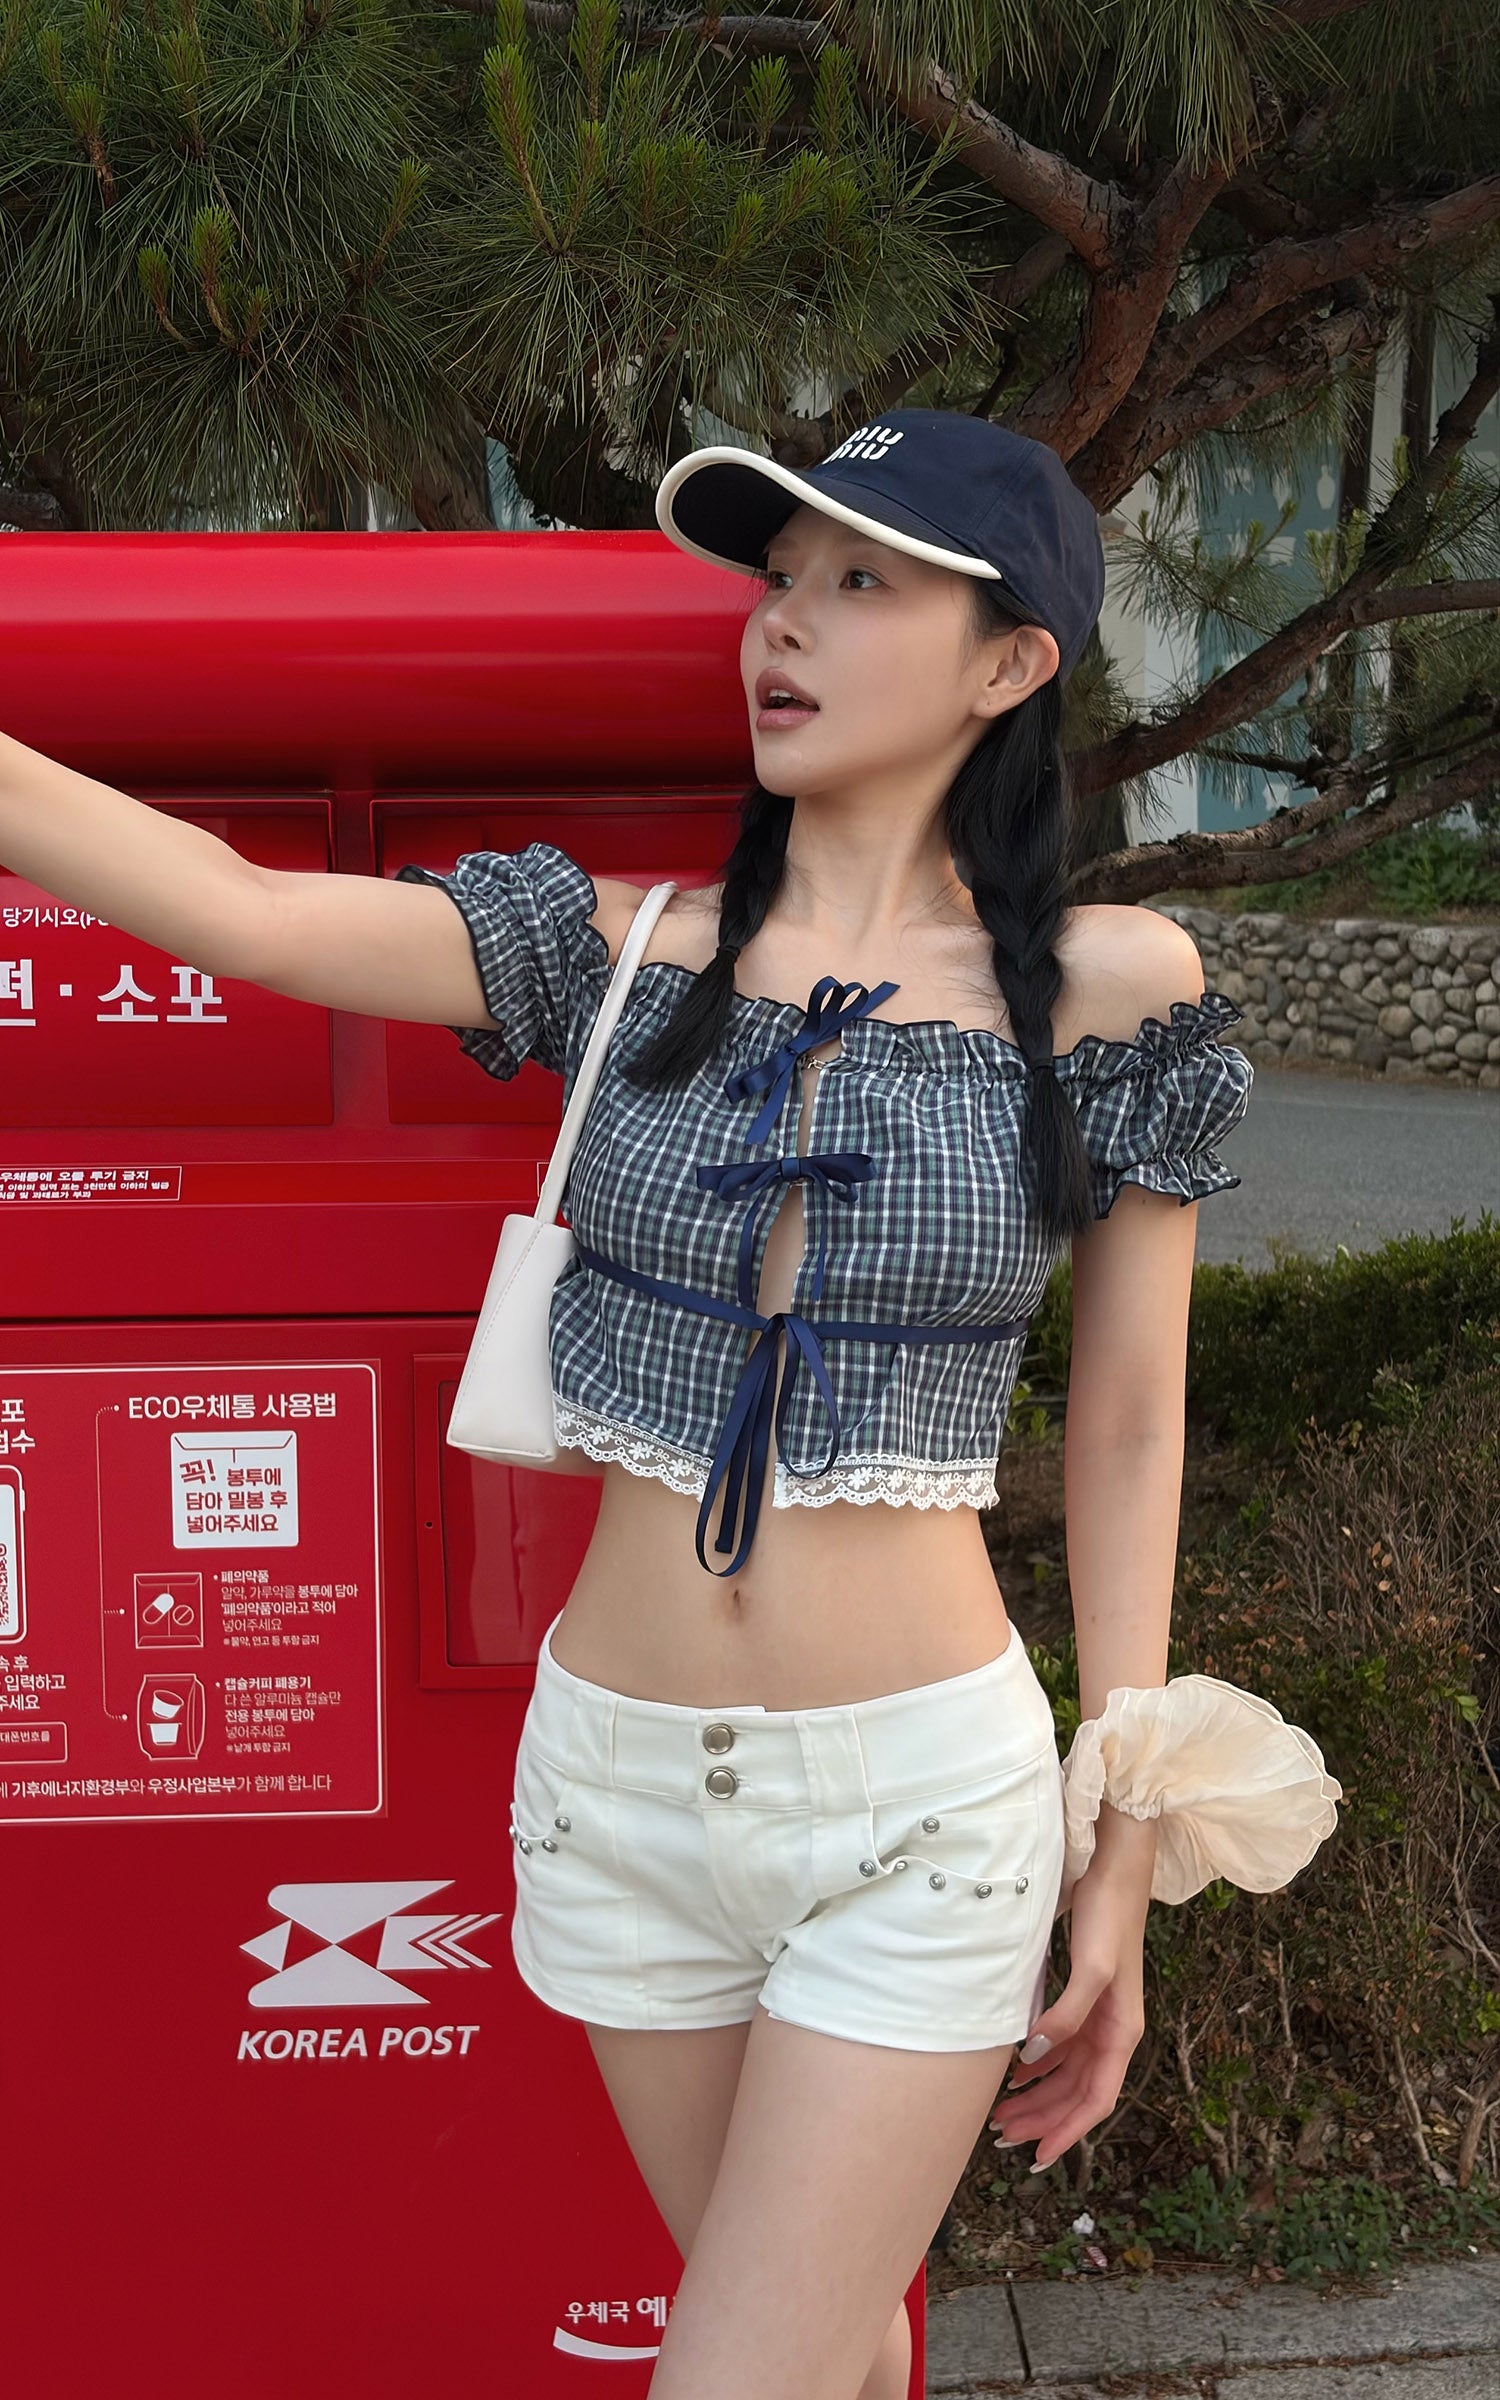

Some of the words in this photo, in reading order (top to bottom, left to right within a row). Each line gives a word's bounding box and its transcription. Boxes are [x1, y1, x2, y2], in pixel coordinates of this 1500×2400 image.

[96, 964, 228, 1024] 소포
[89, 1170, 117, 1182] 투기
[122, 1170, 149, 1181] 금지
[128, 1394, 256, 1420] ECO우체통
[262, 1392, 337, 1418] 사용법
[179, 1458, 217, 1485] 꼭!
[227, 1467, 282, 1487] 봉투에
[185, 1492, 224, 1511] 담아
[228, 1491, 265, 1510] 밀봉
[269, 1490, 289, 1509] 후
[186, 1514, 279, 1534] 넣어주세요
[221, 1570, 270, 1584] 폐의약품
[221, 1586, 248, 1600] 알약,
[250, 1585, 296, 1599] 가루약을
[298, 1584, 333, 1599] 봉투에
[335, 1584, 359, 1598] 담아
[312, 1600, 336, 1615] 적어
[222, 1618, 283, 1633] 넣어주세요
[301, 1634, 320, 1645] 금지
[13, 1654, 29, 1672] 후
[4, 1673, 67, 1692] 입력하고
[224, 1676, 273, 1691] 캡슐커피
[274, 1675, 312, 1690] 폐용기
[224, 1693, 237, 1707] 다
[240, 1692, 252, 1707] 쓴
[254, 1691, 302, 1706] 알루미늄
[305, 1690, 342, 1706] 캡슐만
[225, 1708, 249, 1723] 전용
[251, 1708, 288, 1722] 봉투에
[290, 1707, 315, 1722] 담아
[225, 1724, 286, 1739] 넣어주세요
[273, 1741, 291, 1752] 금지
[12, 1779, 145, 1799] 기후에너지환경부와
[148, 1775, 251, 1795] 우정사업본부가
[254, 1774, 285, 1793] 함께
[287, 1773, 333, 1792] 합니다
[236, 2028, 369, 2060] KOREA
[378, 2025, 481, 2057] POST
[564, 2301, 631, 2325] 우체국
